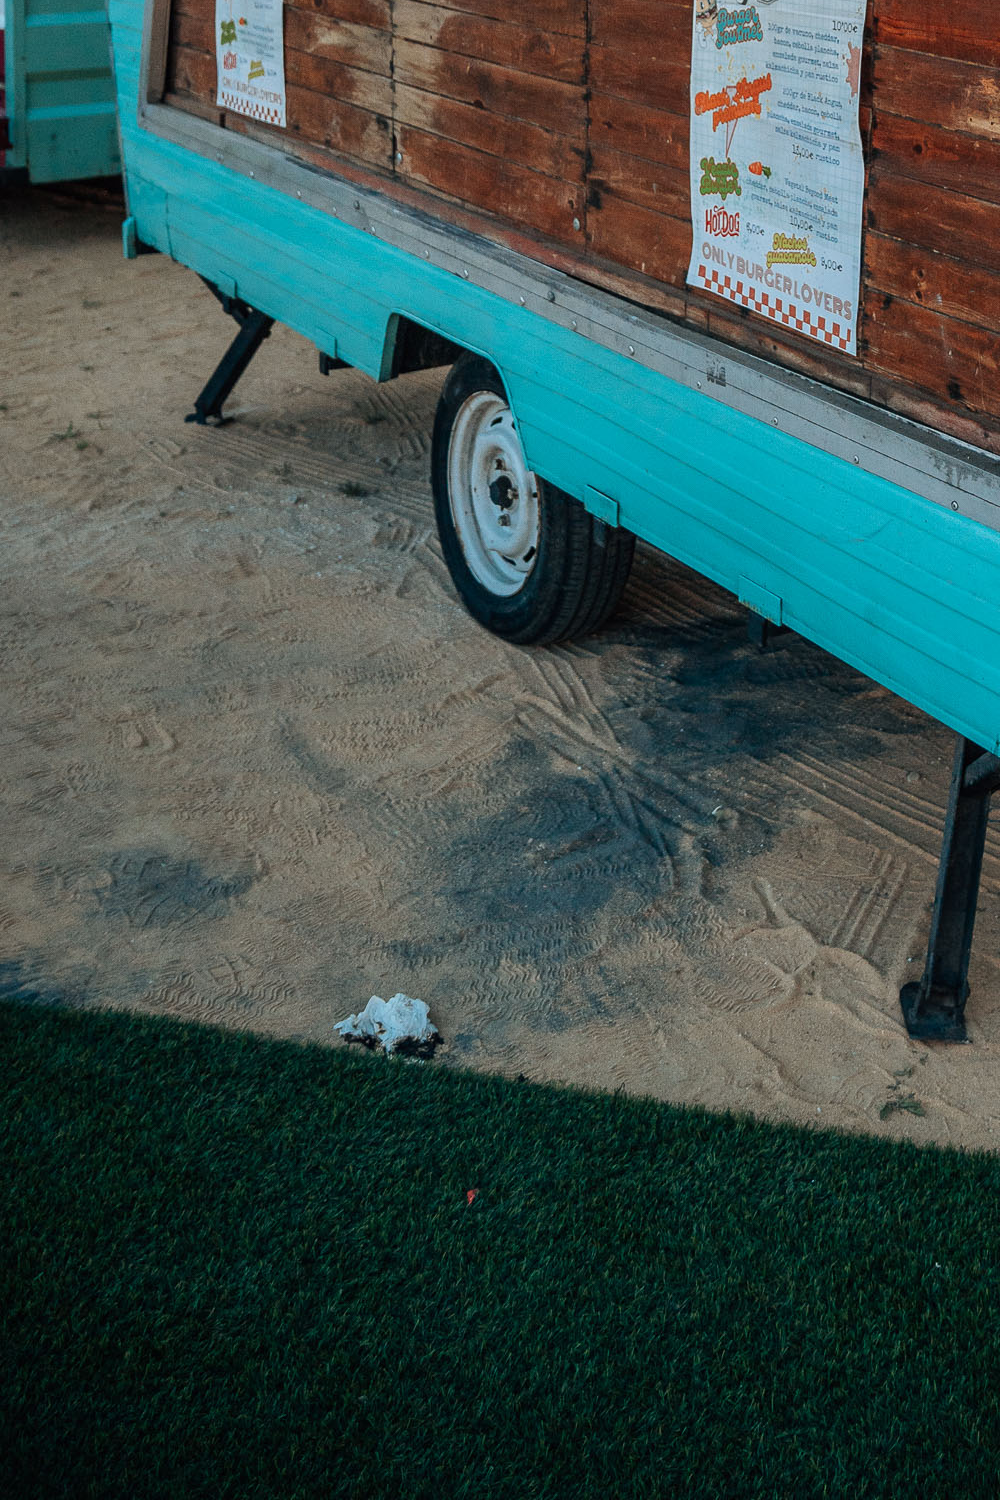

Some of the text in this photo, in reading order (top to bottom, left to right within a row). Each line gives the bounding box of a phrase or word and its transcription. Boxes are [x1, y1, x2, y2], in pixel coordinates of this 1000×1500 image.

[702, 242, 852, 321] ONLY BURGER LOVERS
